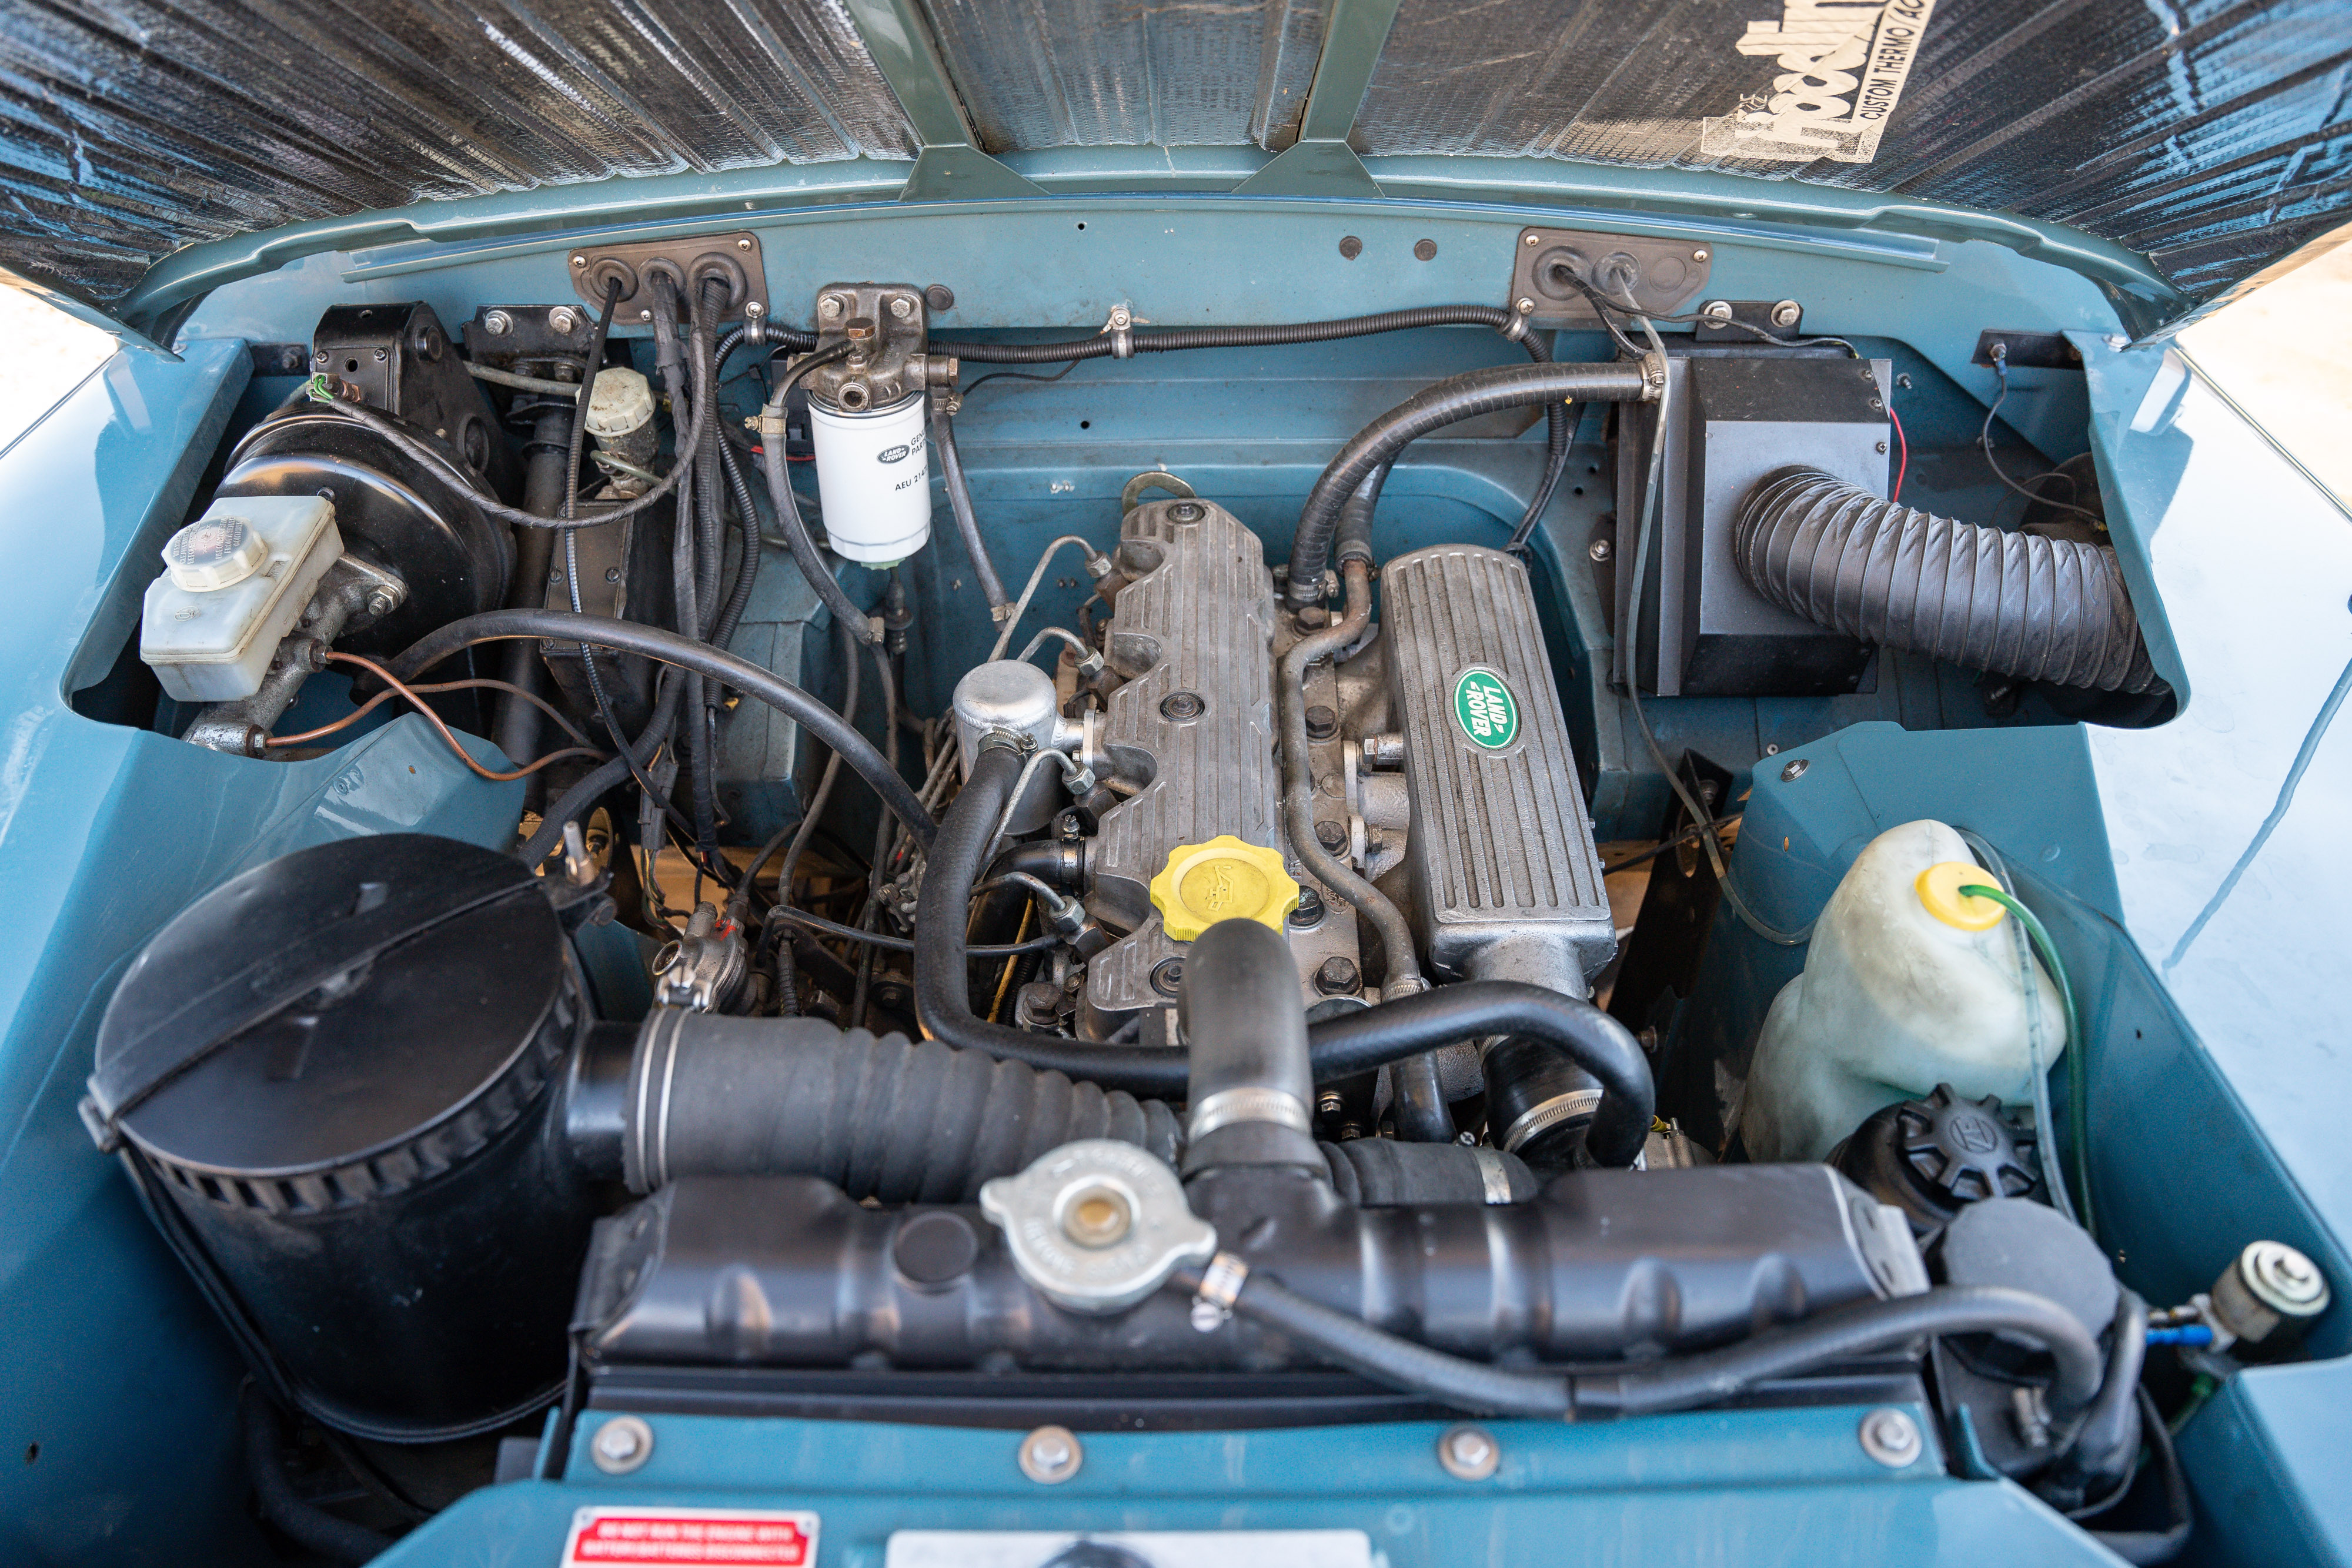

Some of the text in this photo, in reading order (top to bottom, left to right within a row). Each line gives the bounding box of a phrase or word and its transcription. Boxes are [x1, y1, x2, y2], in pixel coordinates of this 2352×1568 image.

[1859, 78, 1897, 120] CUSTOM
[884, 447, 901, 457] LAND
[886, 450, 906, 462] ROVER
[895, 464, 928, 491] AEU 2147
[224, 539, 232, 553] FROM
[233, 521, 243, 546] CONTAINER
[188, 544, 196, 564] BEFORE
[1465, 690, 1492, 737] ROVER
[1483, 686, 1508, 724] LAND
